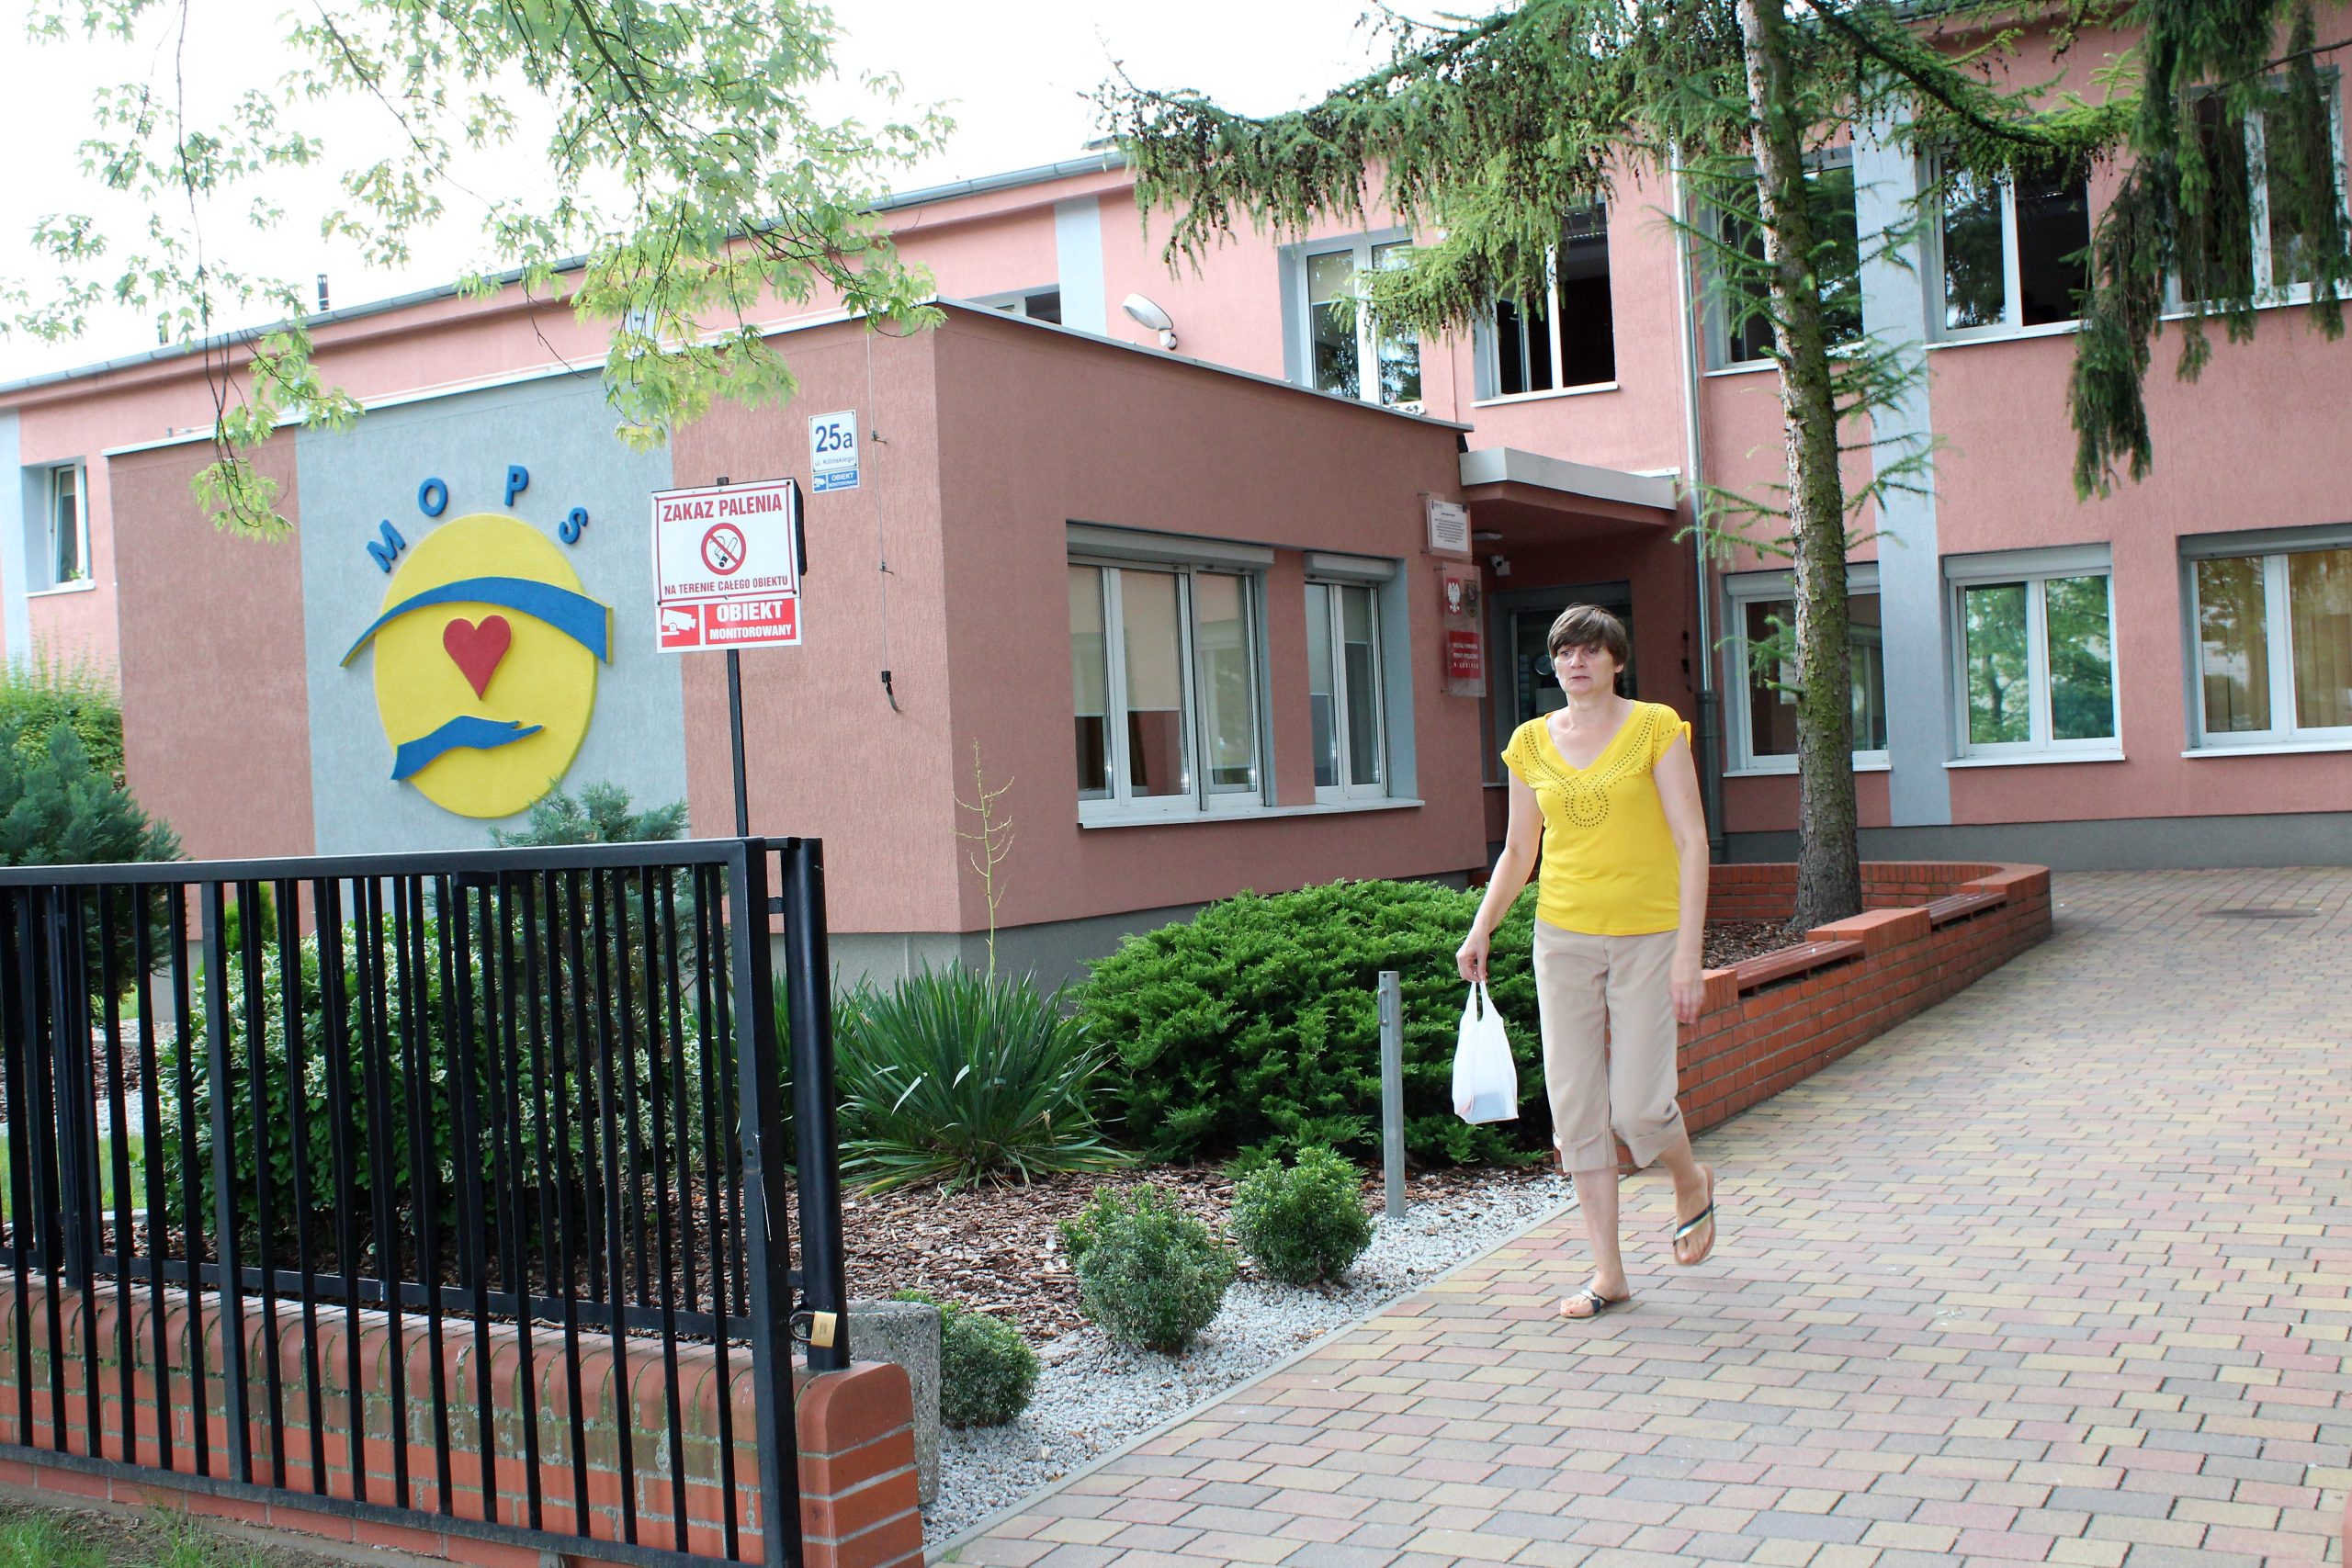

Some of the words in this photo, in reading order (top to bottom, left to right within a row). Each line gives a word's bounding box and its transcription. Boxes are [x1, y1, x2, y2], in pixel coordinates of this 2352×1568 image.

[816, 423, 853, 453] 25a
[831, 472, 854, 481] OBIEKT
[663, 501, 714, 523] ZAKAZ
[719, 493, 783, 517] PALENIA
[664, 585, 676, 595] NA
[679, 581, 715, 594] TERENIE
[718, 579, 751, 592] CAŁEGO
[753, 575, 788, 588] OBIEKTU
[717, 602, 783, 622] OBIEKT
[709, 625, 792, 640] MONITOROWANY
